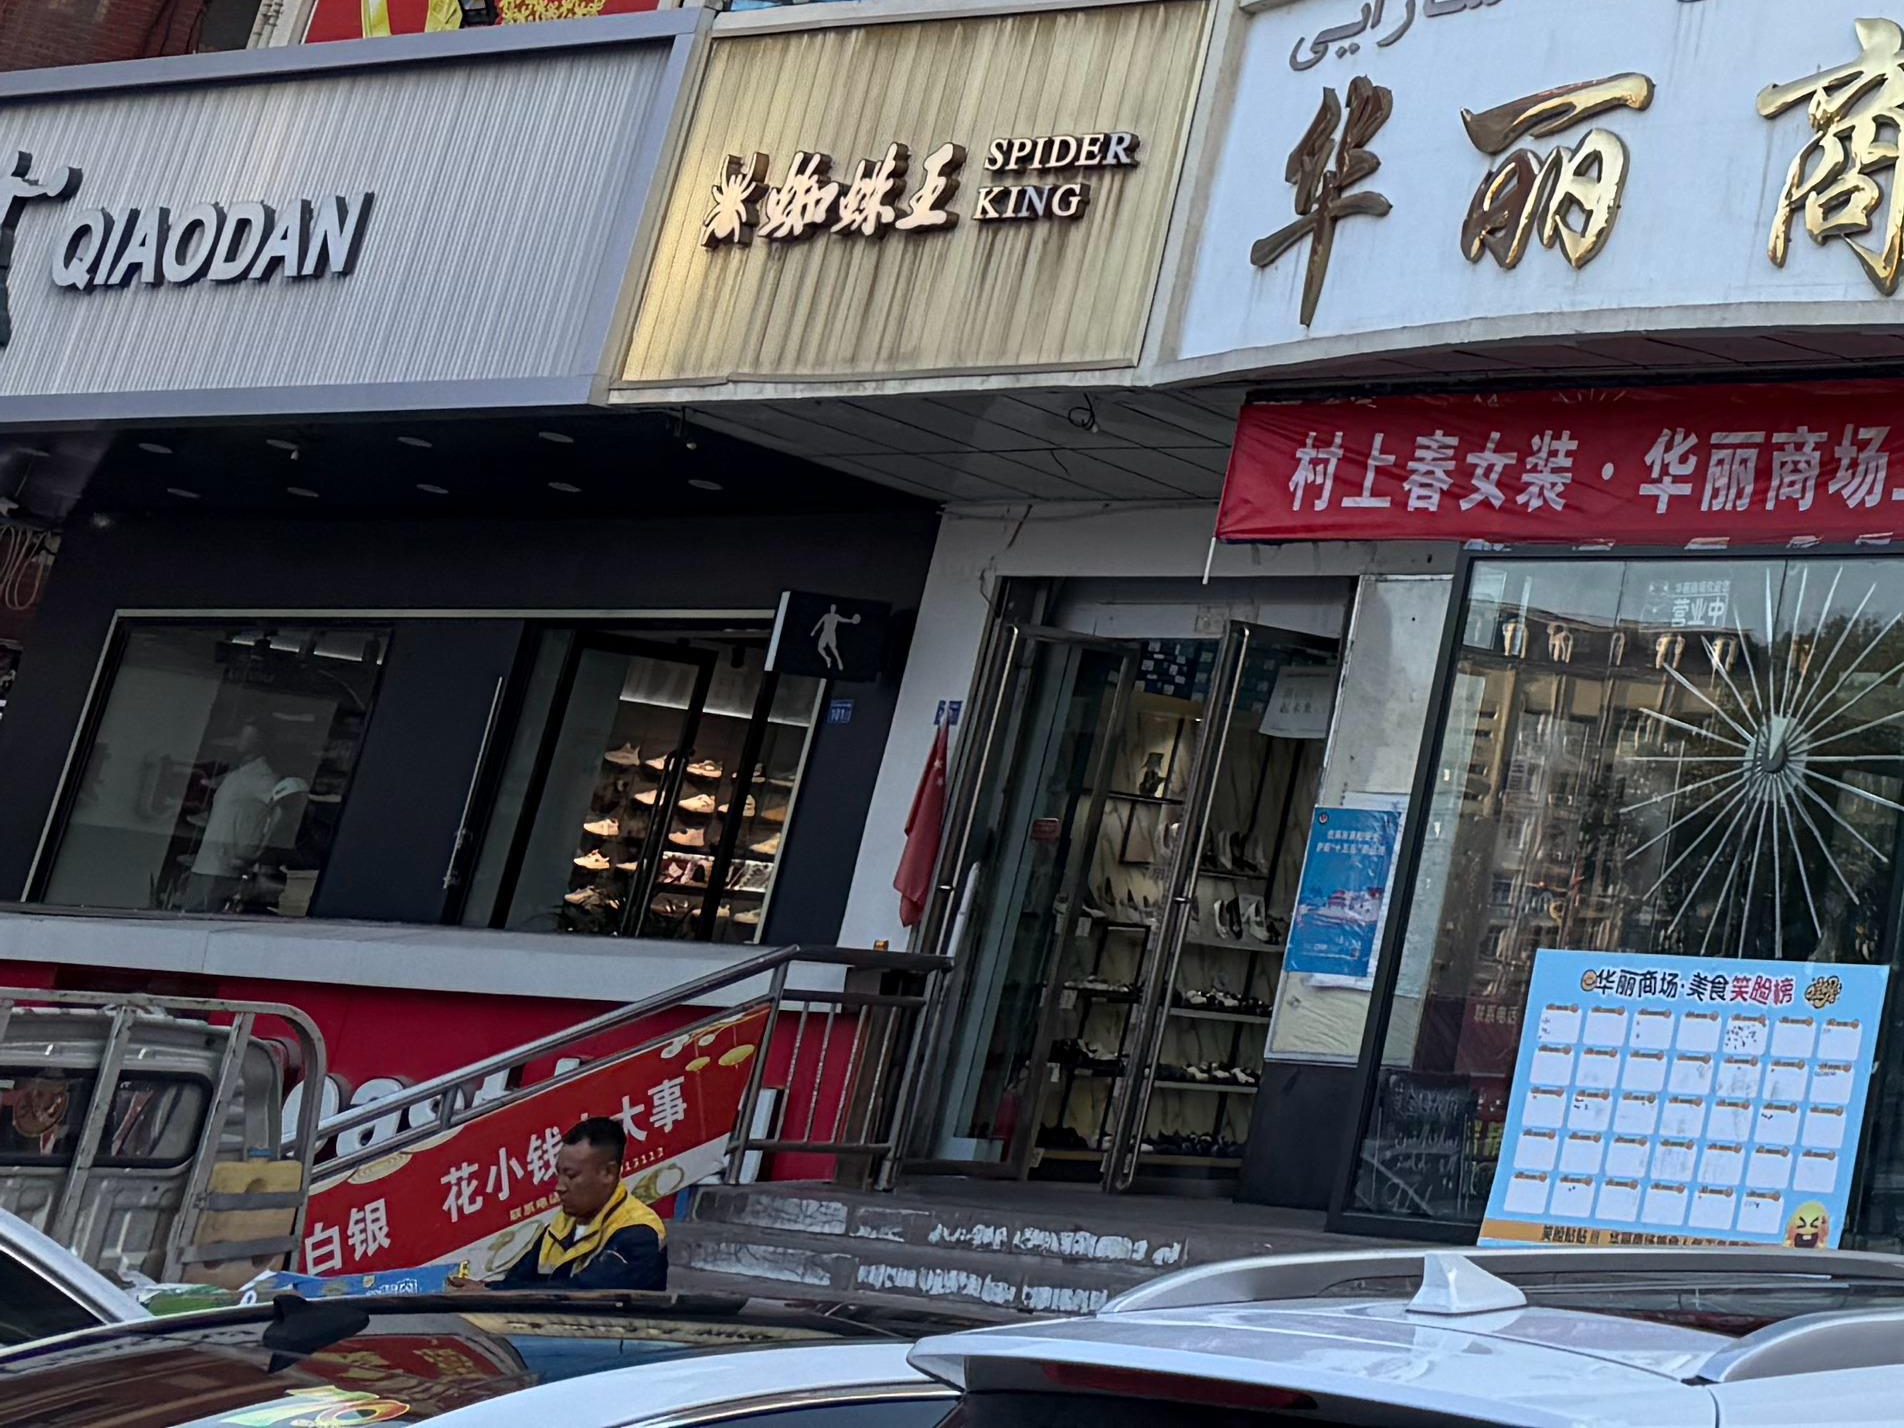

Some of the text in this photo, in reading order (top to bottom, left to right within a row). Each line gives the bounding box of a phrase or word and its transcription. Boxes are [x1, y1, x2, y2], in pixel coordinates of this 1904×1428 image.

[984, 132, 1136, 174] SPIDER
[758, 142, 960, 238] 蜘蛛王
[972, 183, 1084, 221] KING
[50, 189, 370, 291] QIAODAN
[1671, 596, 1725, 627] 营业中
[304, 1198, 391, 1275] 白银
[440, 1075, 688, 1223] 花小钱大事
